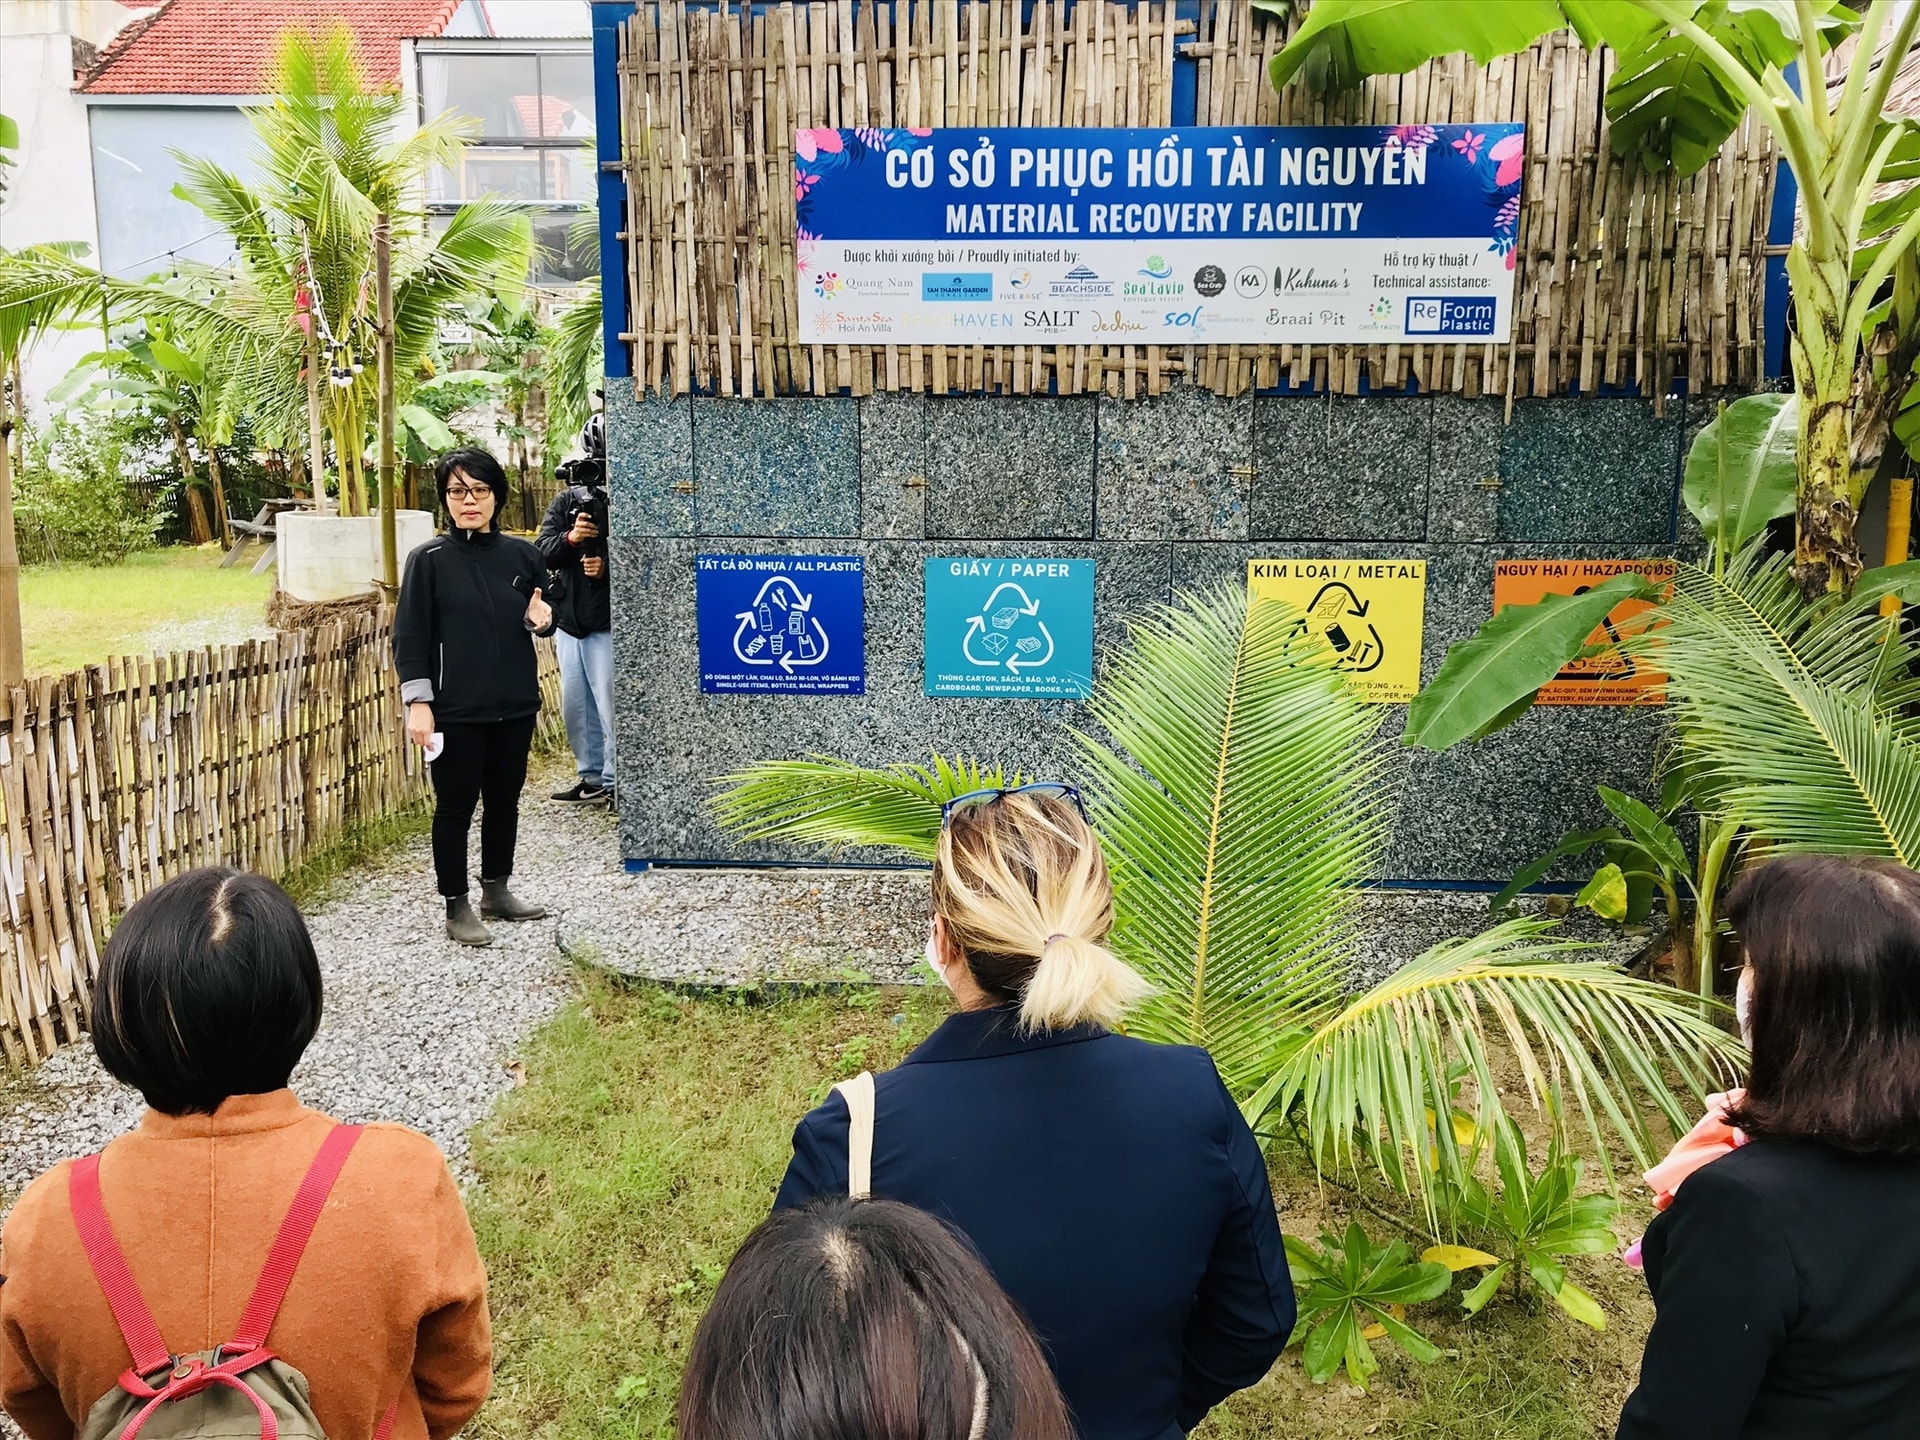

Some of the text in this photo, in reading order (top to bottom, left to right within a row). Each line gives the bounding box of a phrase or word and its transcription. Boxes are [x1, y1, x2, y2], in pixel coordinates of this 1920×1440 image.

[885, 135, 1426, 196] CƠ SỞ PHỤC HỒI TÀI NGUYÊN
[946, 202, 1363, 233] MATERIAL RECOVERY FACILITY
[844, 249, 871, 265] Được
[968, 249, 1009, 264] Proudly
[1013, 249, 1060, 262] initiated
[1064, 249, 1080, 264] by:
[1439, 253, 1468, 269] thuật
[846, 277, 913, 289] Quang Nam
[1284, 267, 1351, 291] Kahuna's
[1373, 275, 1491, 288] Technical assistance:
[1052, 285, 1111, 293] BEACHSIDE
[1024, 310, 1079, 327] SALT
[1266, 309, 1346, 326] Braai Pit
[1442, 320, 1490, 330] Plastic
[839, 324, 892, 332] Hoi An Villa
[795, 562, 815, 571] ALL
[817, 561, 861, 572] PLASTIC
[950, 559, 1070, 577] GIẤY / PAPER
[1254, 565, 1287, 578] KIM
[1344, 565, 1350, 579] /
[1358, 565, 1420, 579] METAL
[1498, 564, 1538, 576] NGUY
[1543, 564, 1568, 578] HẠI
[1572, 564, 1579, 577] /
